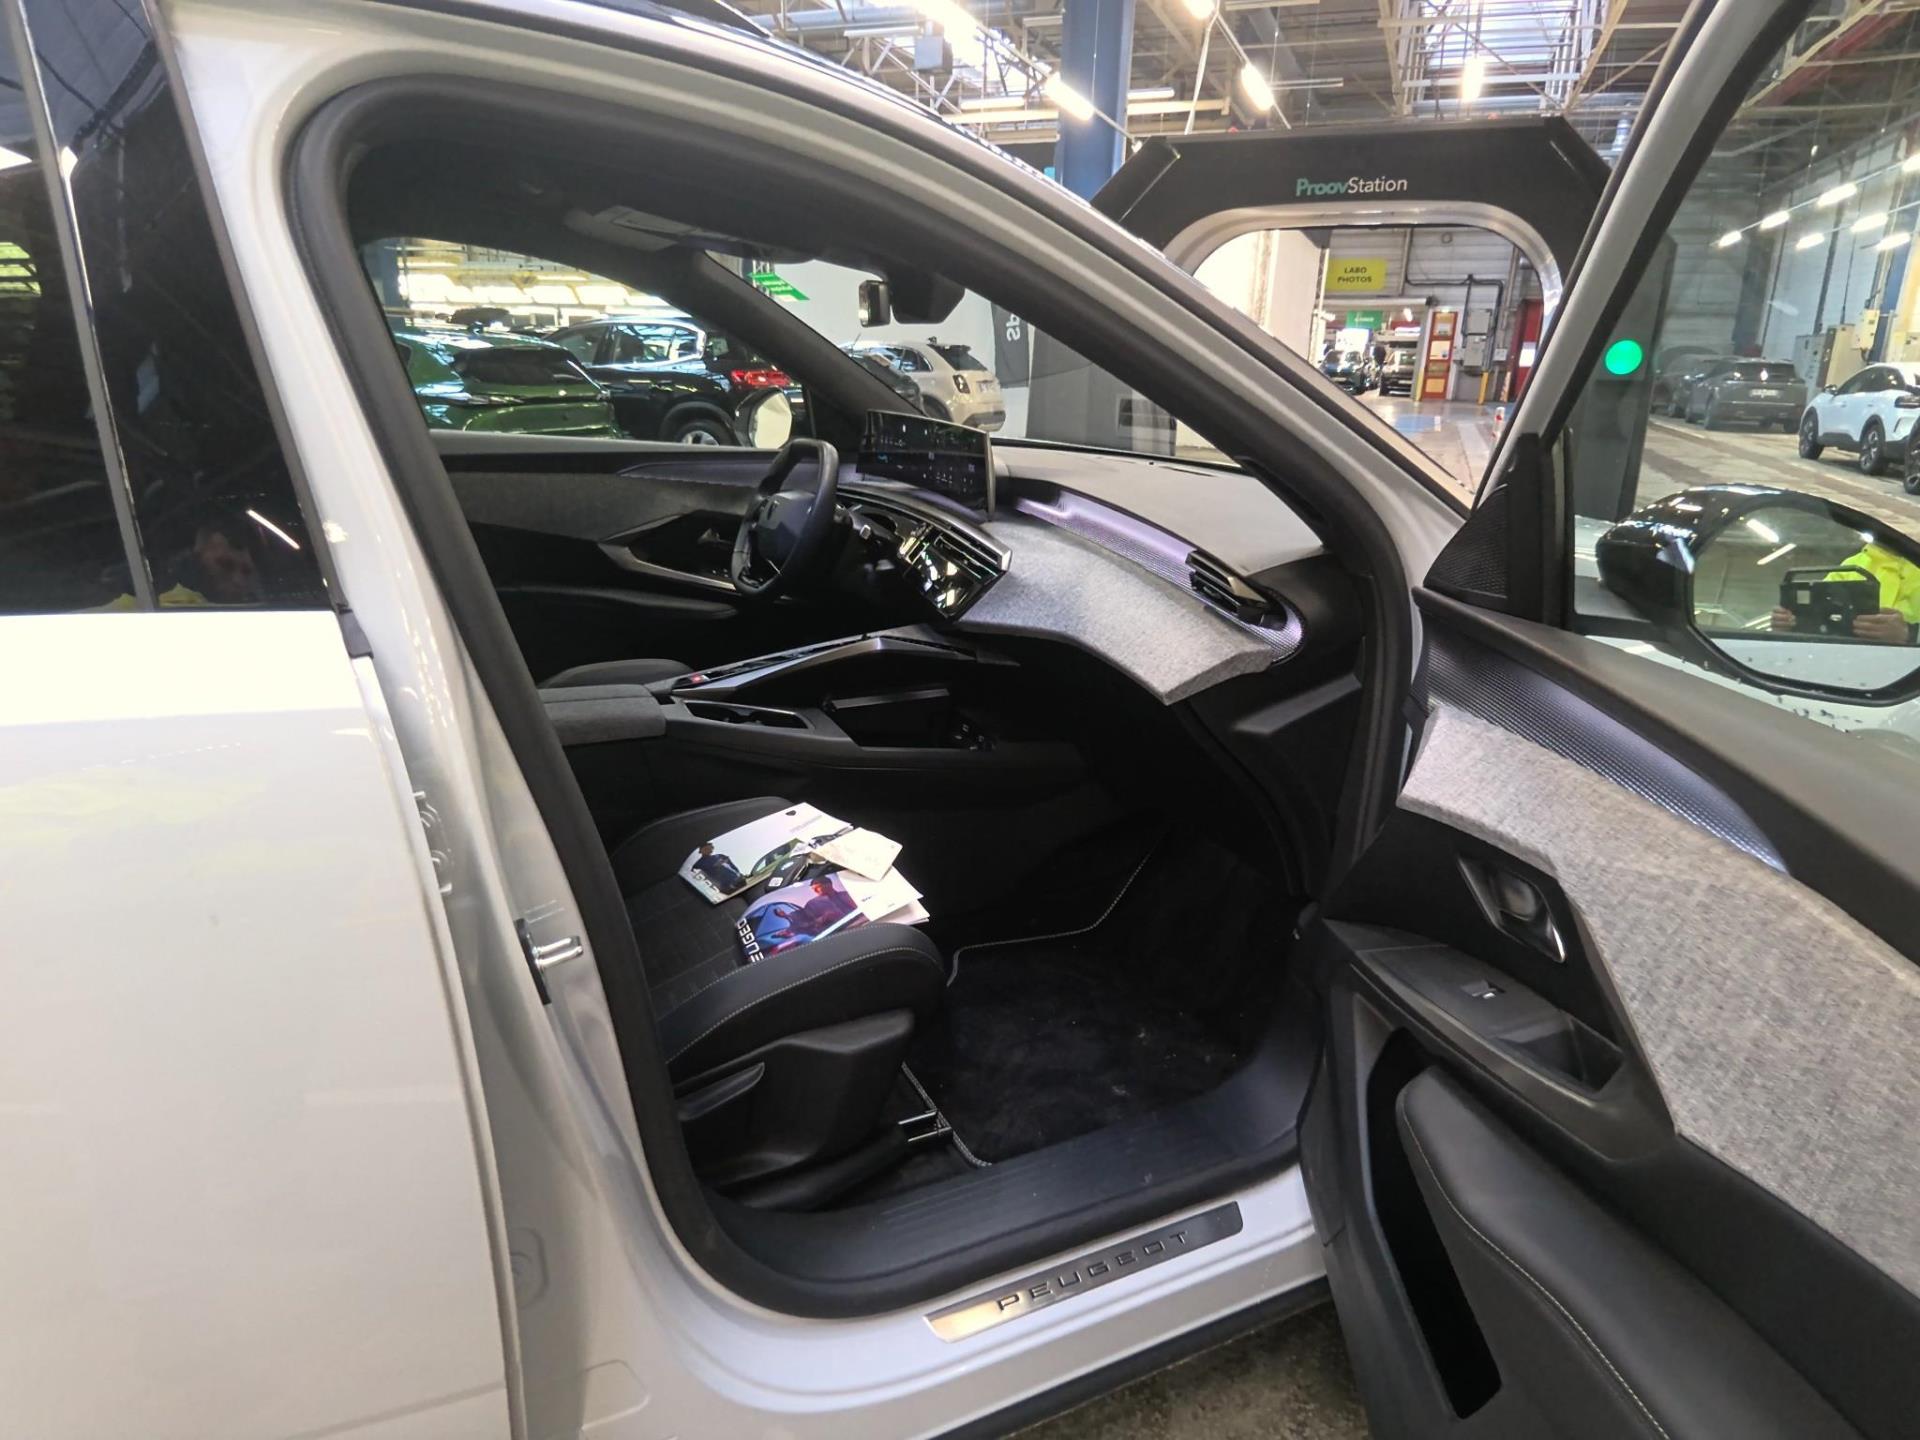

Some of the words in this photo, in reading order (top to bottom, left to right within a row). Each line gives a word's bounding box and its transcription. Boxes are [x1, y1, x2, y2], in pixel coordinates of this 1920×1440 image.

[1296, 175, 1408, 197] ProovStation
[1344, 266, 1367, 274] LABO
[1337, 275, 1372, 284] PHOTOS
[997, 1230, 1189, 1311] PEUGEOT
